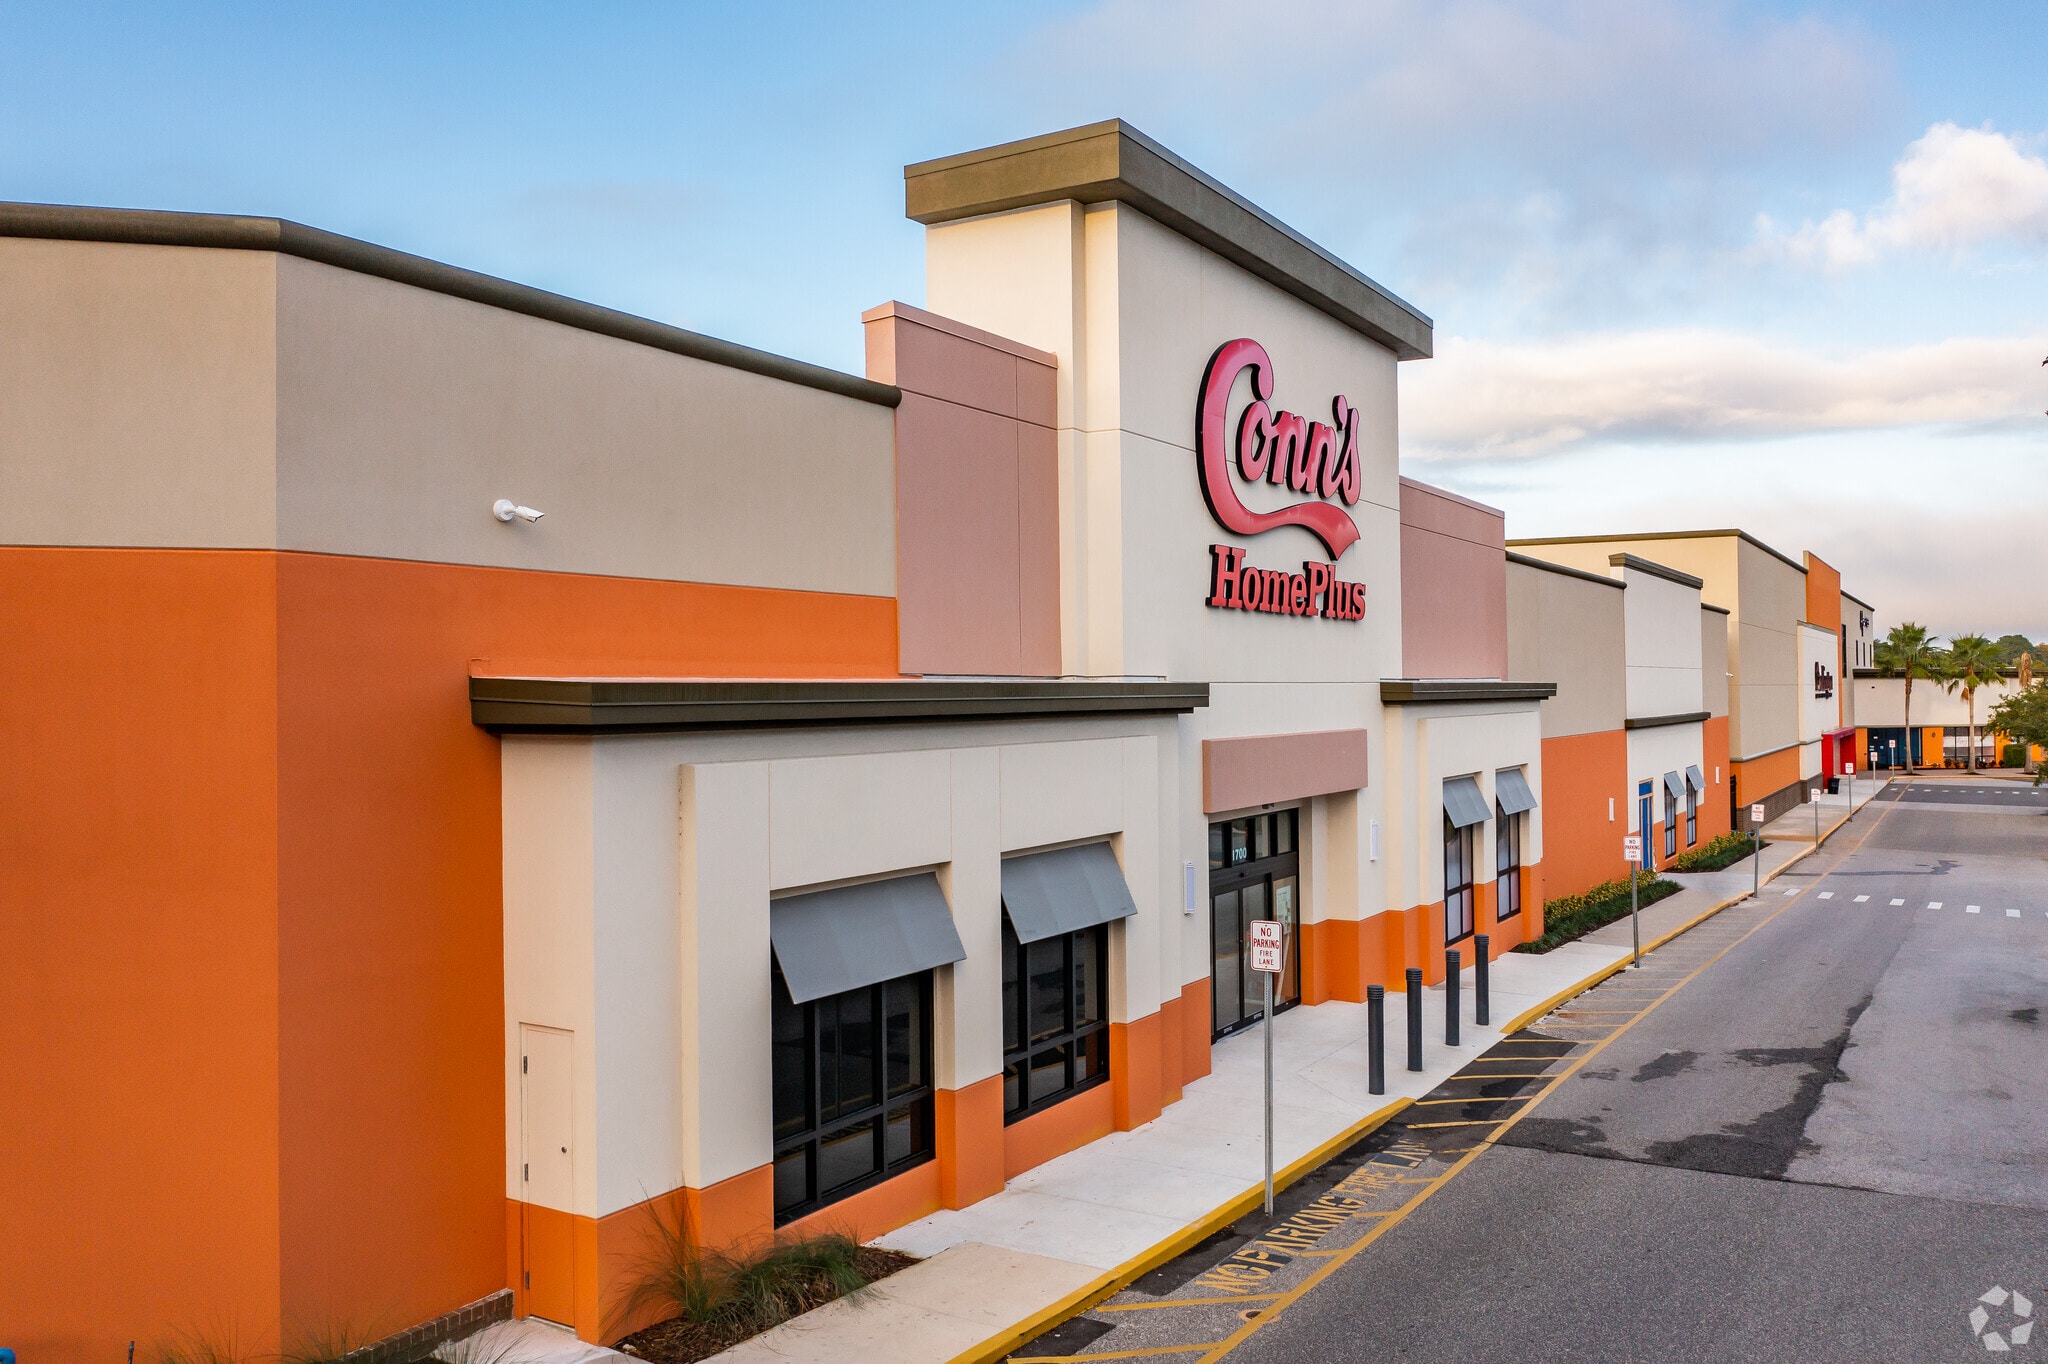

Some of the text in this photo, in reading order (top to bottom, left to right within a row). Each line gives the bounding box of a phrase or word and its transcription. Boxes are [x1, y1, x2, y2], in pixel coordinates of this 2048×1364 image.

[1195, 337, 1361, 561] Conn's
[1205, 543, 1367, 621] HomePlus
[1232, 847, 1247, 861] 1700
[1260, 927, 1272, 937] NO
[1253, 938, 1280, 950] PARKING
[1259, 949, 1273, 958] FIRE
[1258, 958, 1274, 966] LANE
[1231, 1195, 1368, 1268] PARKING
